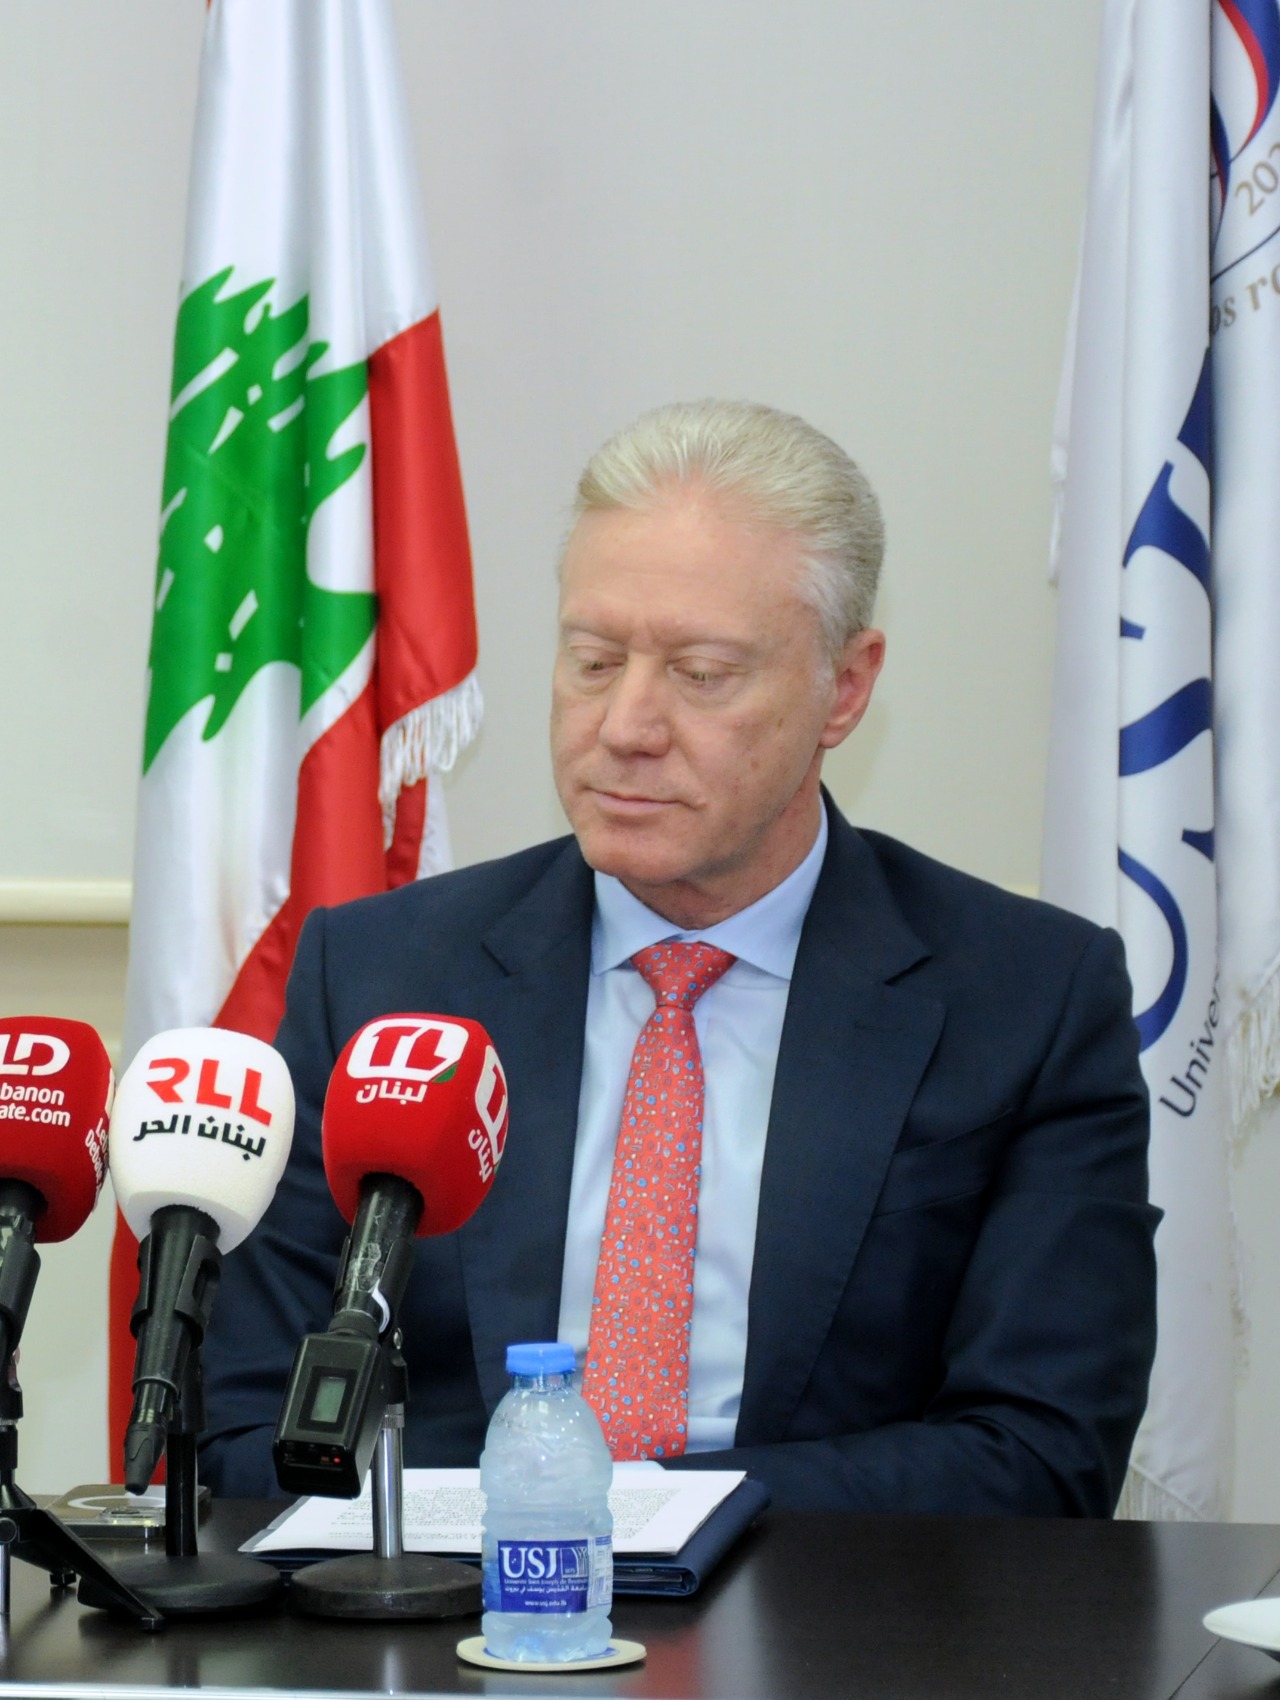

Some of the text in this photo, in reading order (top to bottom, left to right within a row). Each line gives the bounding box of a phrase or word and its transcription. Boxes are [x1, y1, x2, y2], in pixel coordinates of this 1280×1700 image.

[146, 1058, 272, 1127] RLL
[356, 1080, 428, 1105] لبنان
[133, 1114, 267, 1161] لبنان الحر
[500, 1547, 559, 1579] USJ
